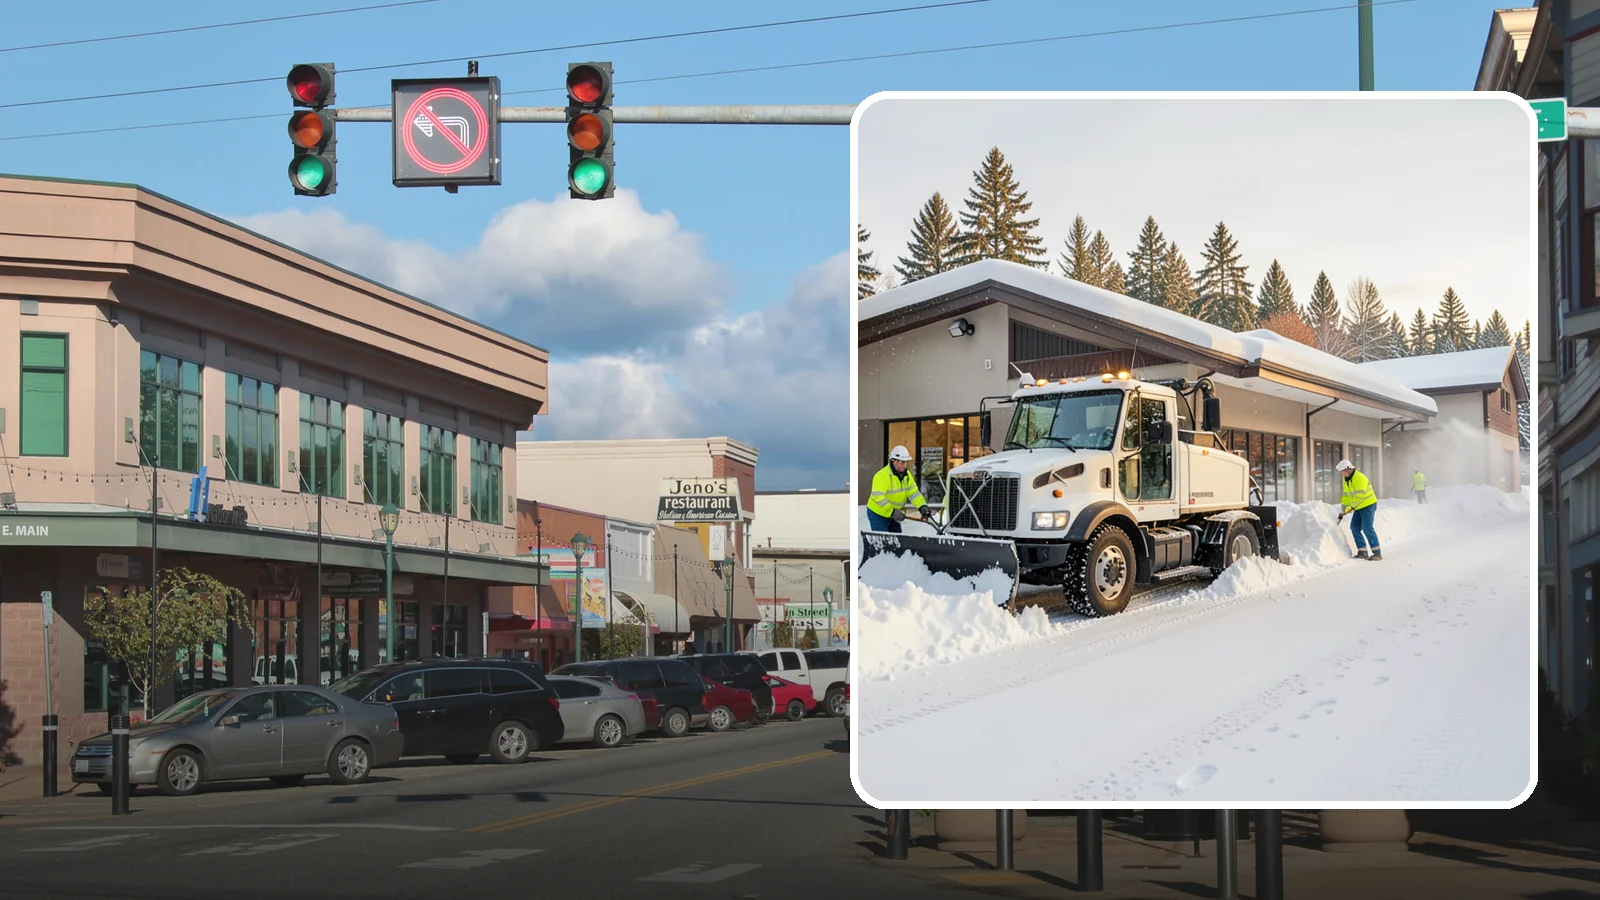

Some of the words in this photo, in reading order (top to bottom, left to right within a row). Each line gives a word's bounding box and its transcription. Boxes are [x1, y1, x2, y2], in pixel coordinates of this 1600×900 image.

[670, 480, 728, 494] Jeno's
[665, 496, 731, 509] restaurant
[686, 509, 714, 519] American
[715, 509, 738, 519] Cuisine
[2, 525, 13, 536] E.
[15, 525, 49, 536] MAIN
[797, 607, 828, 617] Street
